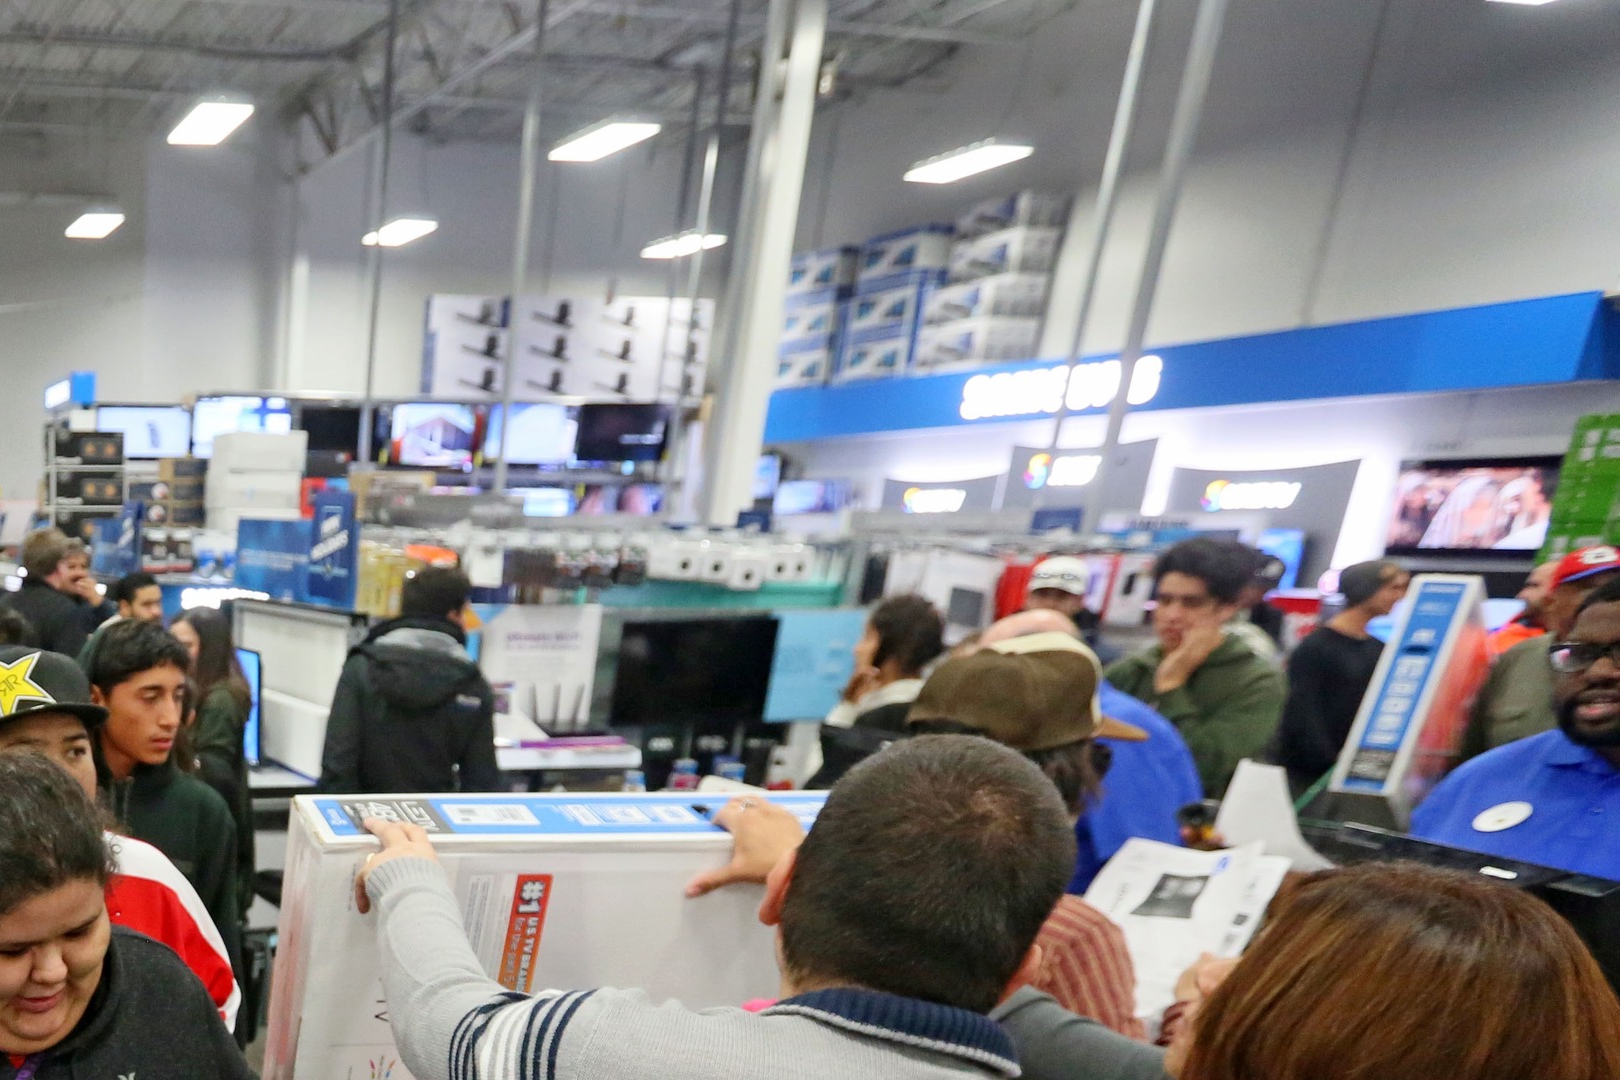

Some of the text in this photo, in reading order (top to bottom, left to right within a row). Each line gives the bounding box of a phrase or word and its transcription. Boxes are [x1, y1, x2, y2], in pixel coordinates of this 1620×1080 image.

[518, 881, 545, 914] #1
[514, 918, 526, 931] for
[526, 917, 539, 936] US
[510, 933, 522, 952] the
[523, 937, 535, 953] TV
